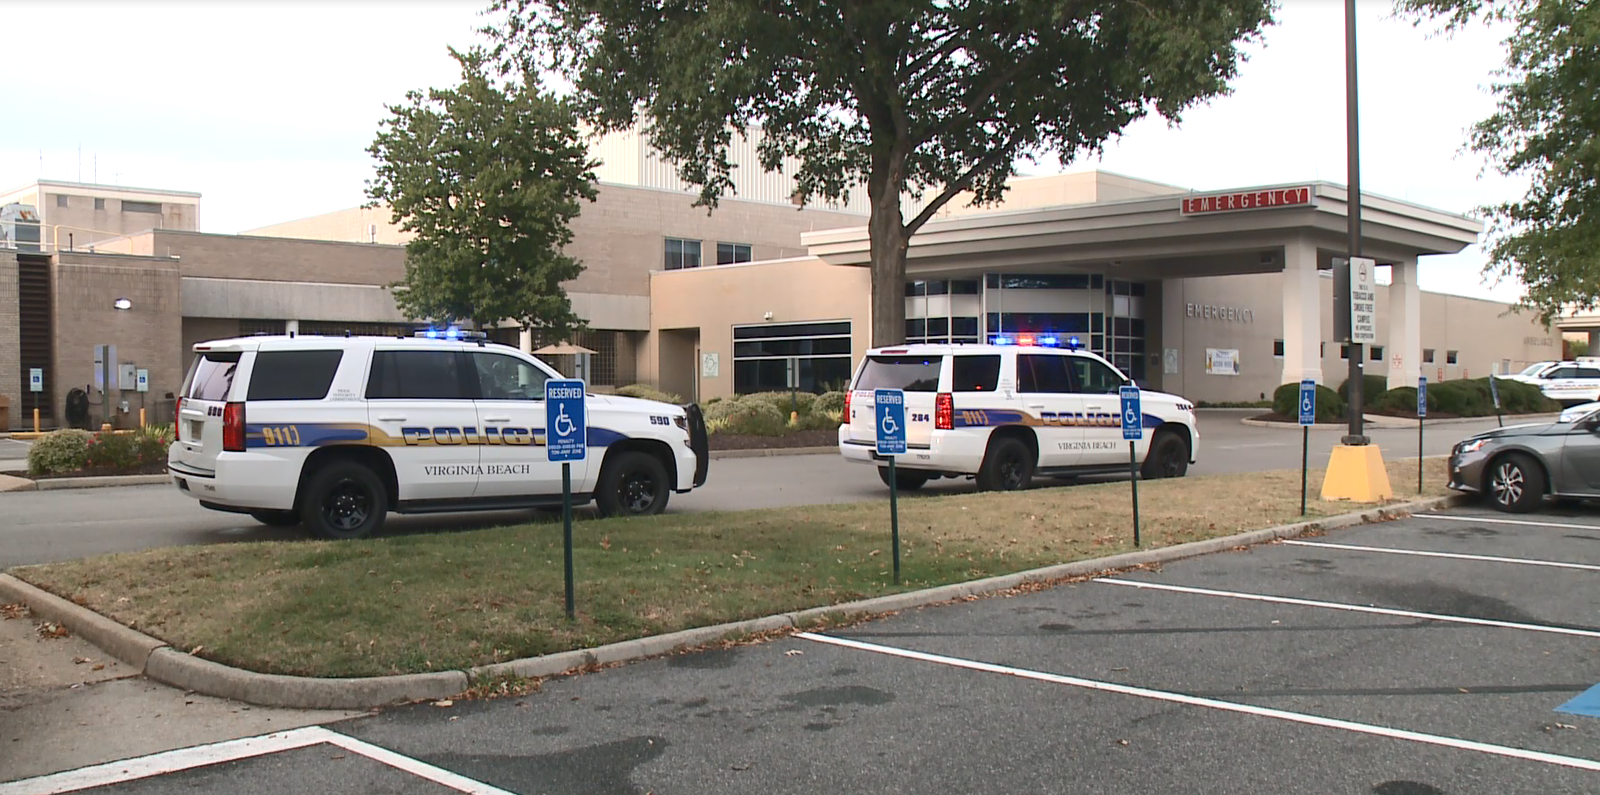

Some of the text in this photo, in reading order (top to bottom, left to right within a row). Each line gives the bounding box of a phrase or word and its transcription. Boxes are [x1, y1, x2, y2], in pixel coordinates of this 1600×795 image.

[1188, 189, 1302, 212] EMERGENCY
[1186, 302, 1256, 324] EMERGENCY
[1365, 303, 1373, 313] FREE
[548, 387, 582, 399] RESERVED
[876, 394, 902, 404] RESERVED
[650, 415, 670, 426] 590
[911, 413, 930, 422] 284
[1058, 441, 1117, 450] VIRGINIA BEACH
[424, 464, 531, 476] VIRGINIA BEACH
